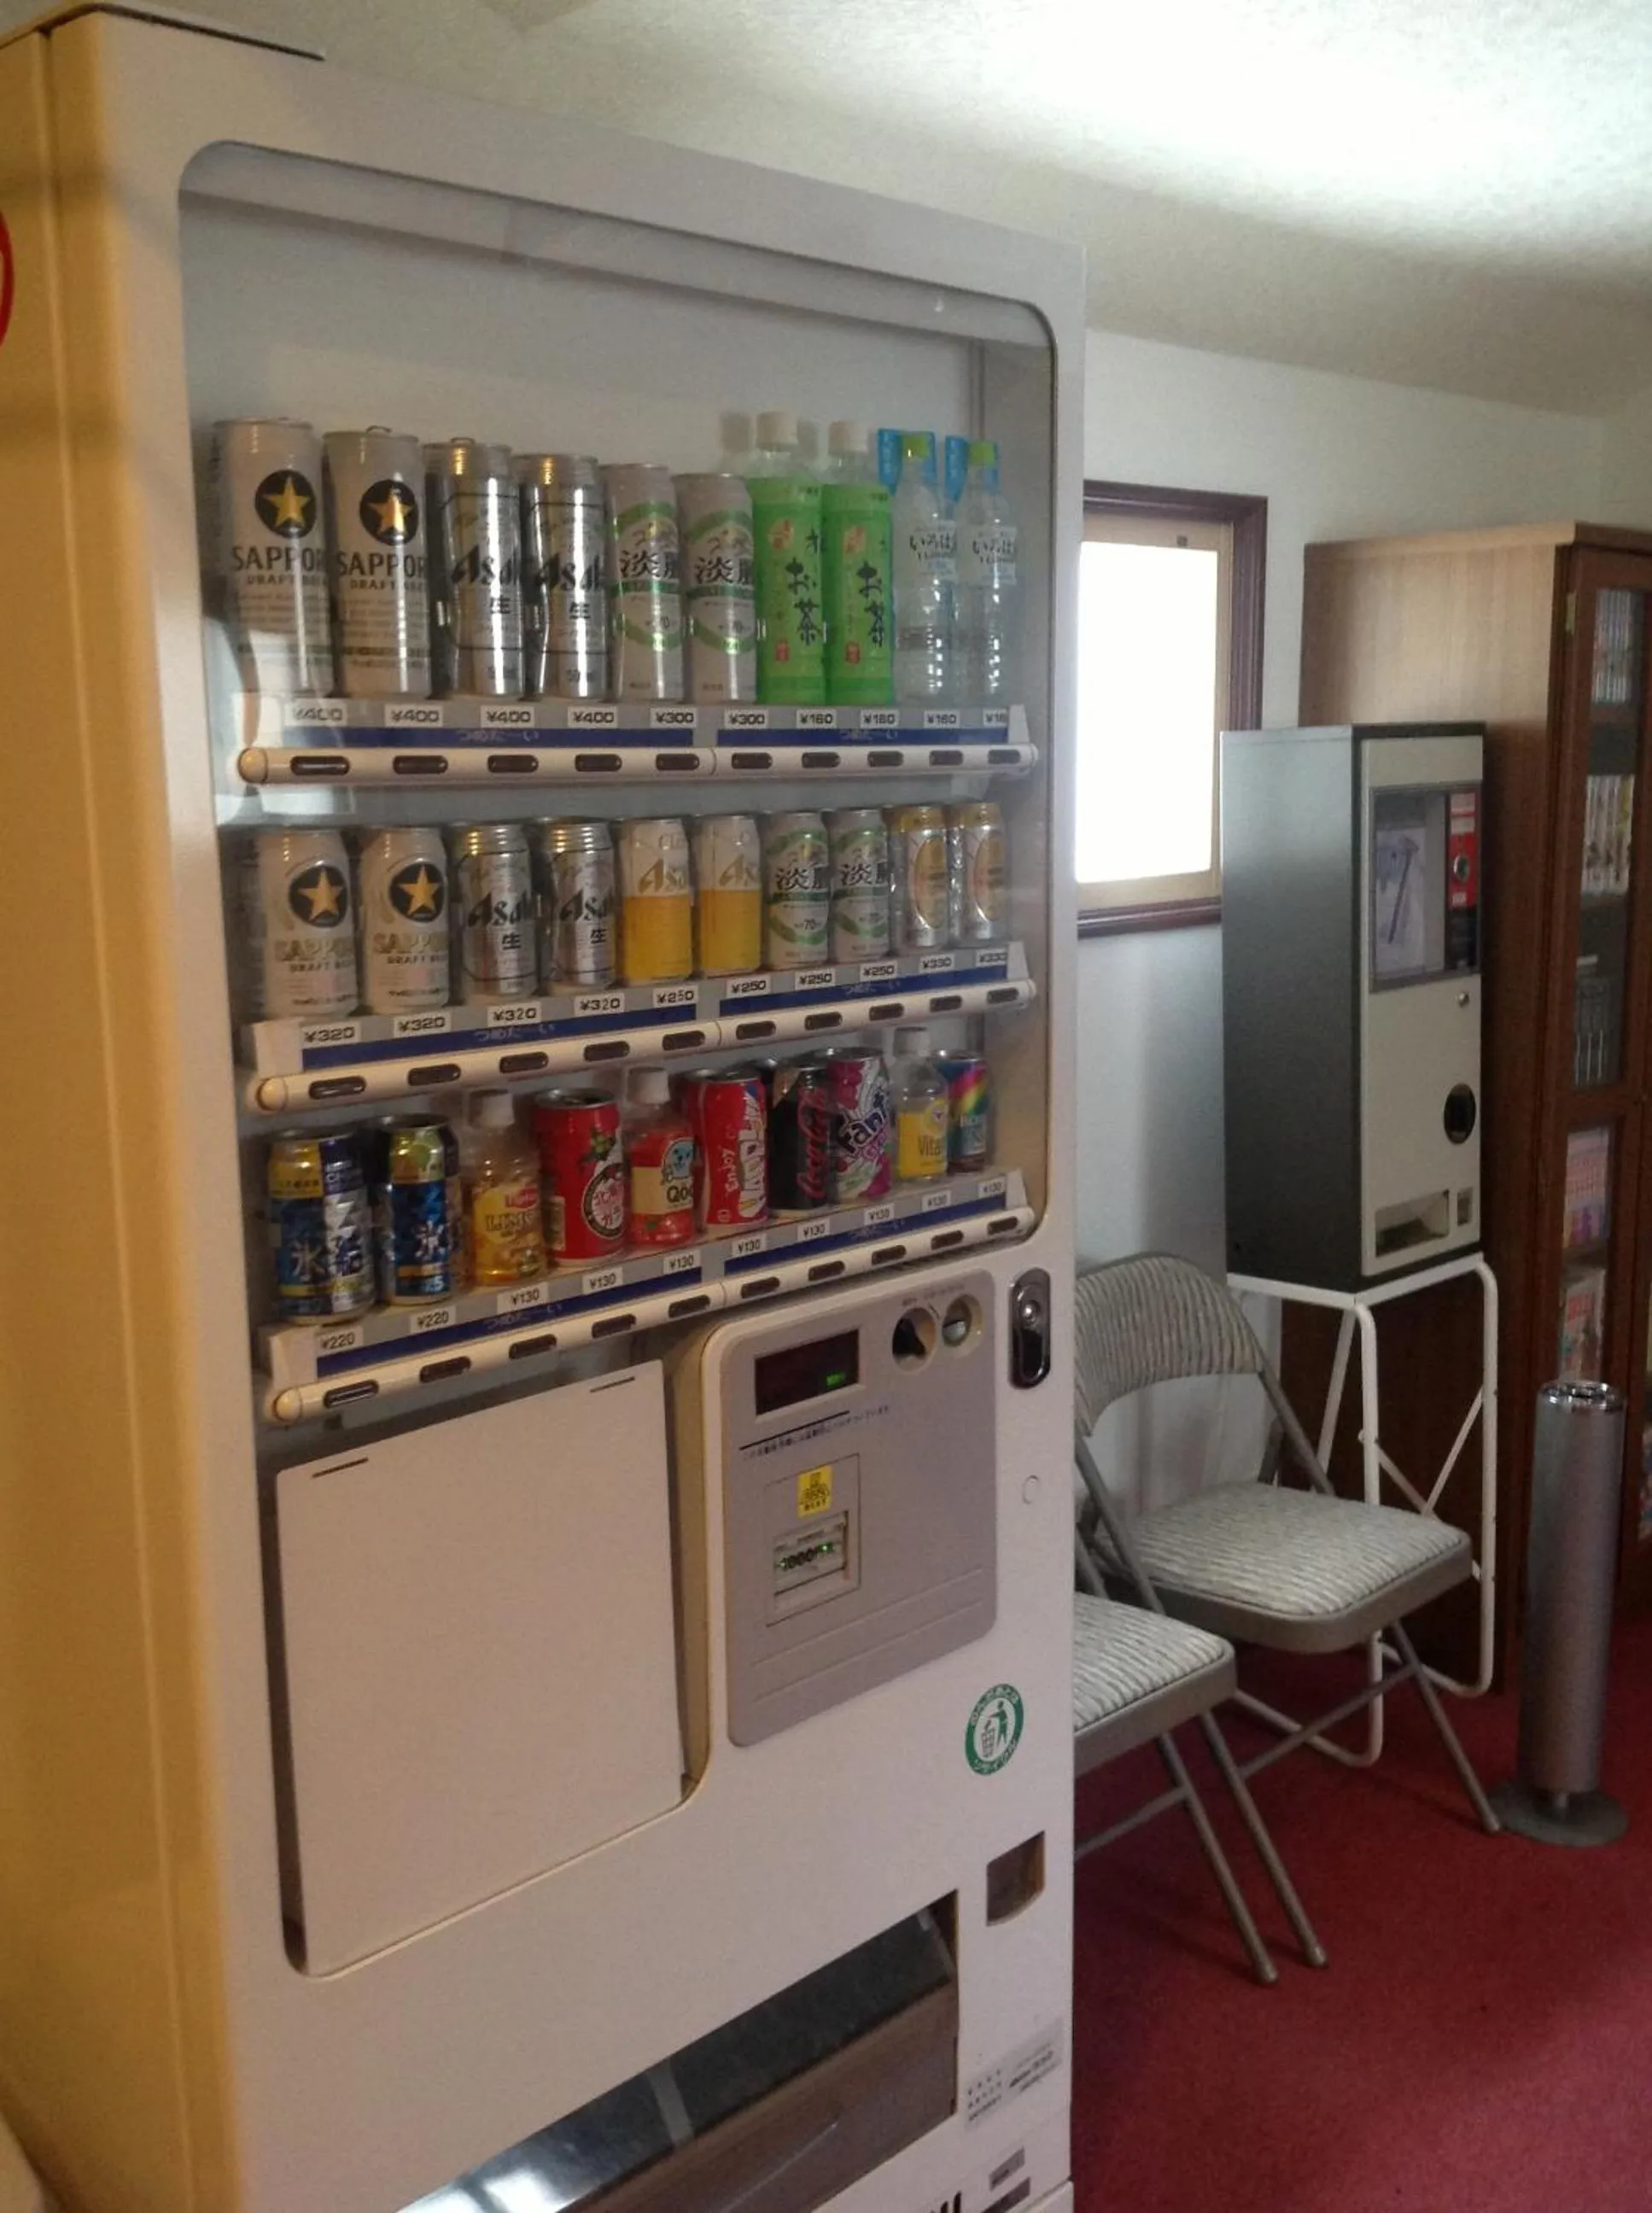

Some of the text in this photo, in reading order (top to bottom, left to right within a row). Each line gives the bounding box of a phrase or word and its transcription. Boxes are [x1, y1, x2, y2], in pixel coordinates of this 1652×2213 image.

[340, 552, 426, 577] SAPPOR
[392, 709, 440, 722] ¥400
[487, 710, 532, 723] ¥400
[573, 711, 615, 724] ¥400
[656, 711, 695, 724] ¥300
[729, 713, 766, 725] ¥300
[732, 981, 767, 993] ¥250
[657, 990, 694, 1004] ¥250
[581, 998, 621, 1011] ¥320
[493, 1007, 537, 1022] ¥320
[398, 1017, 446, 1032] ¥320
[304, 1026, 355, 1043] ¥320
[417, 1311, 450, 1327] ¥220
[321, 1333, 356, 1349] ¥220
